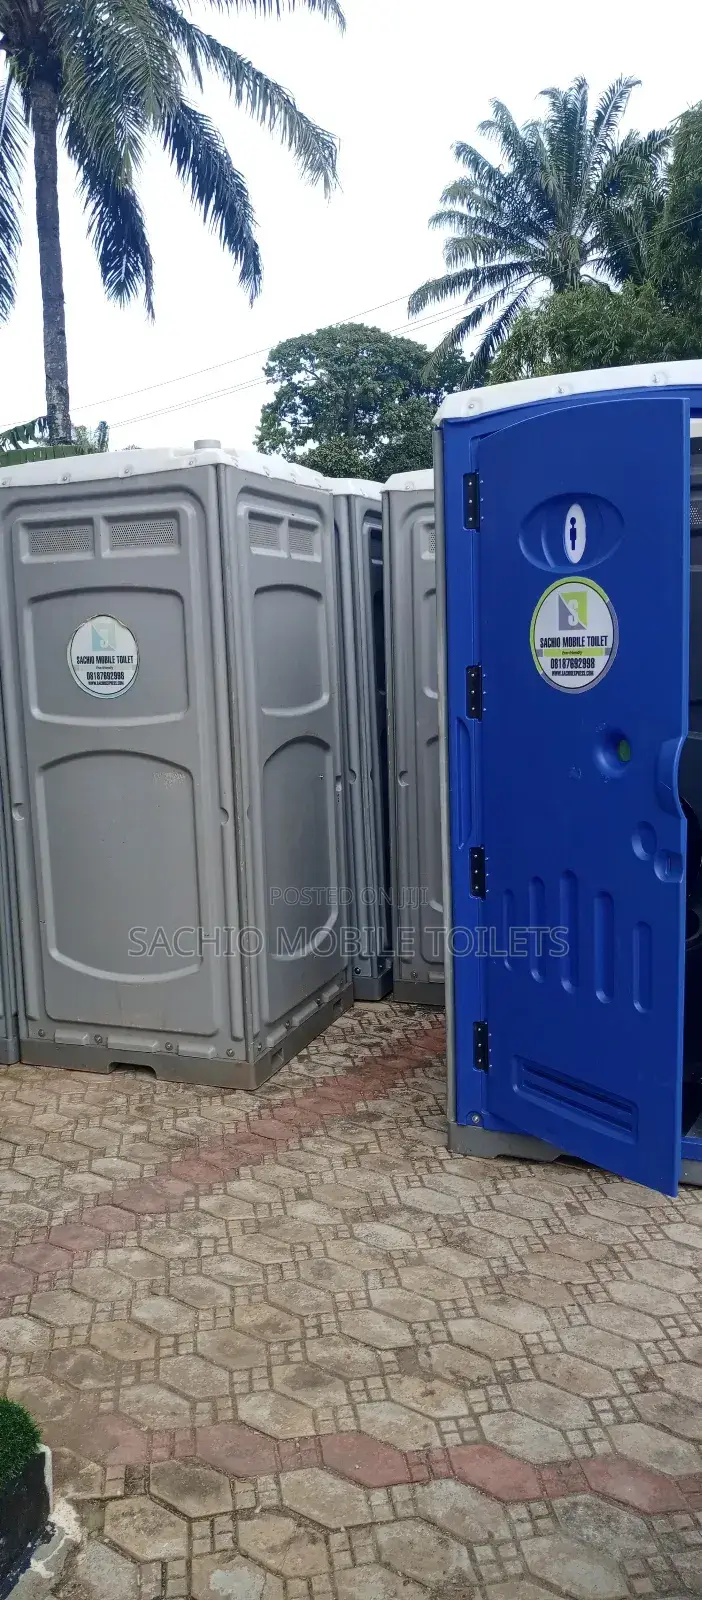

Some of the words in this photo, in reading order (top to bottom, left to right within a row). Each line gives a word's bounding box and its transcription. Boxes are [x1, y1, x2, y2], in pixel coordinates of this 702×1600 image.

[567, 599, 579, 627] S
[540, 637, 561, 648] SACHIO
[562, 636, 585, 648] MOBILE
[587, 635, 608, 646] TOILET
[76, 655, 94, 664] SACHIO
[96, 655, 115, 664] MOBILE
[116, 655, 134, 664] TOILET
